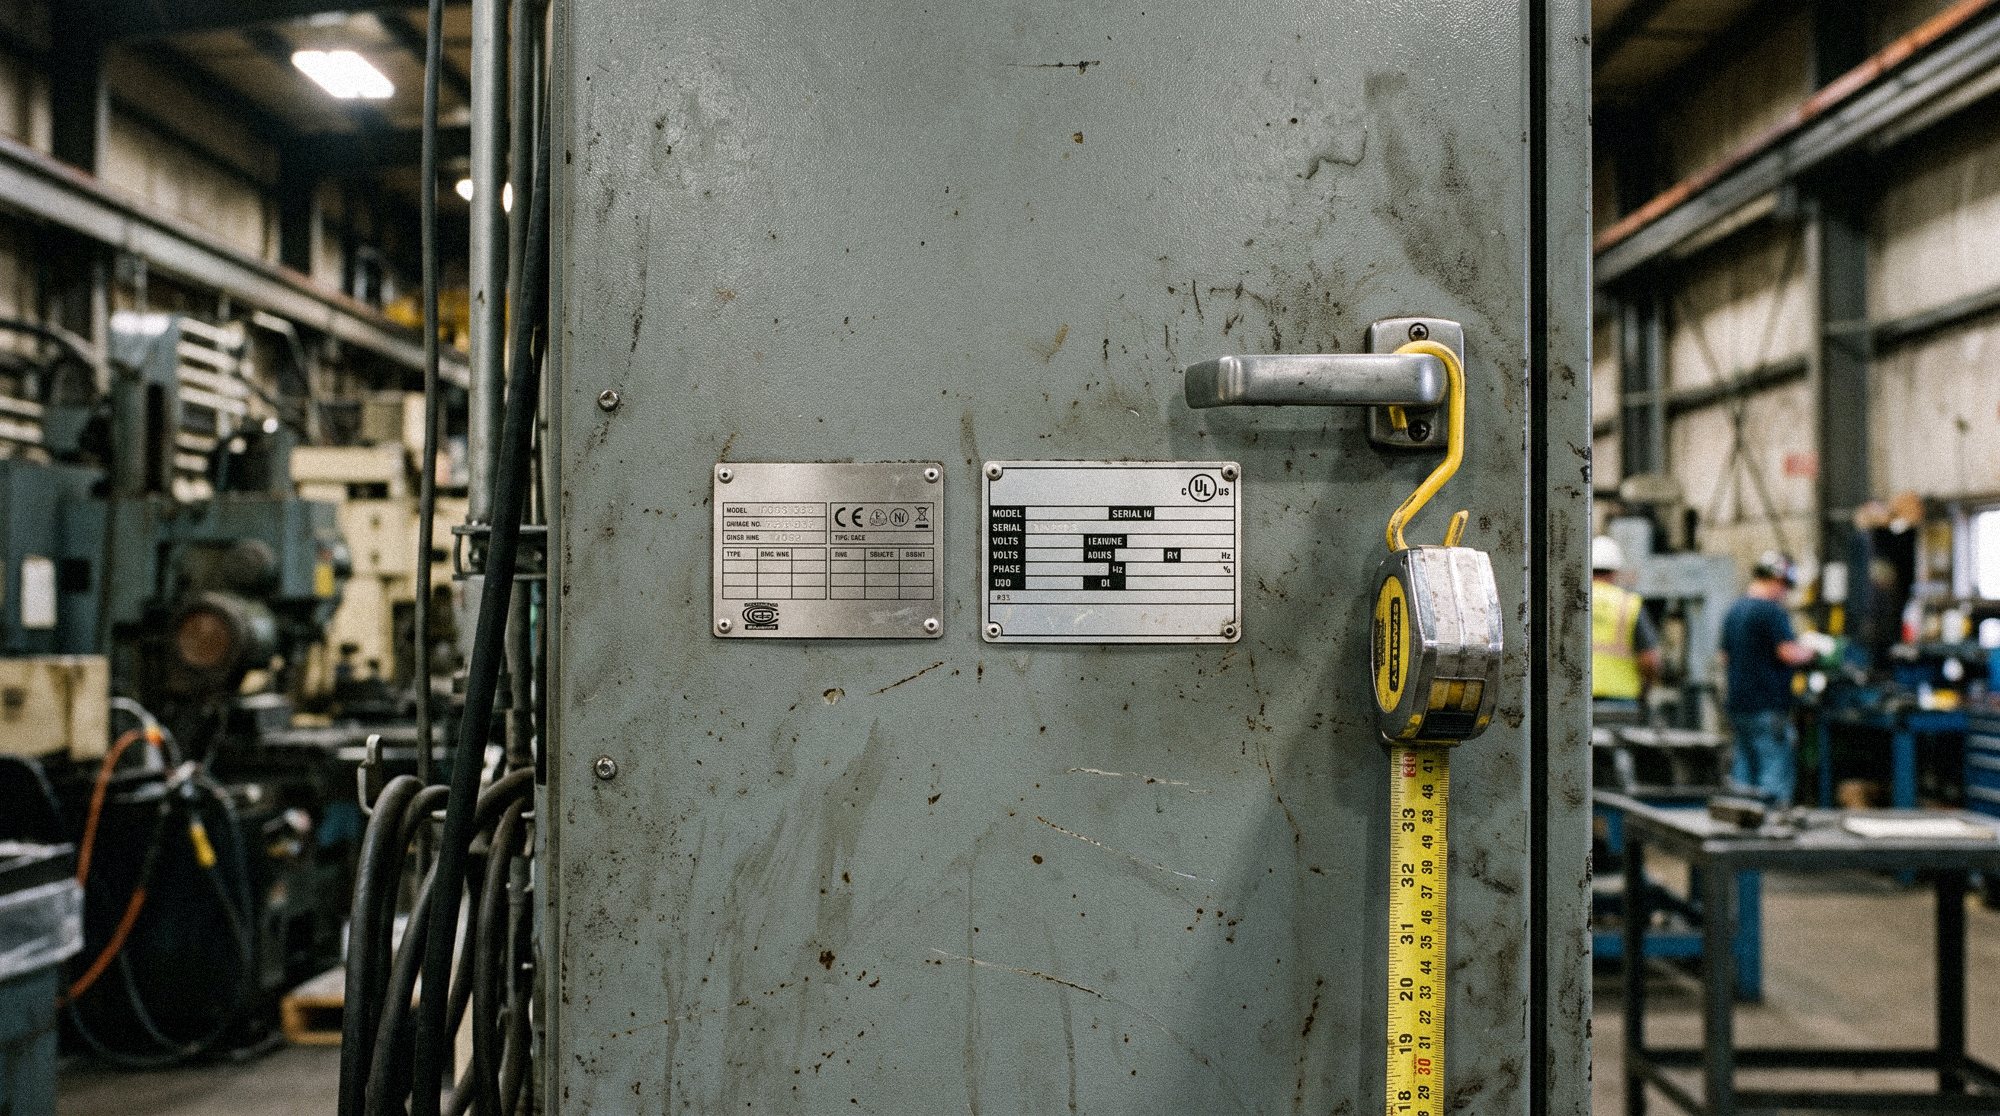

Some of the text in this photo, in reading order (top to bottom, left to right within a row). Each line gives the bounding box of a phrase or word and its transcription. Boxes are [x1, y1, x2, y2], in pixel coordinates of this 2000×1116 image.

[1194, 480, 1210, 496] UL
[1219, 488, 1230, 496] US
[834, 507, 864, 528] CE
[992, 509, 1022, 518] MODEL
[1112, 509, 1142, 518] SERIAL
[992, 523, 1022, 532] SERIAL
[992, 537, 1018, 545] VOLTS
[993, 551, 1018, 559] VOLTS
[993, 565, 1021, 573] PHASE
[1402, 808, 1416, 832] 33
[1422, 835, 1433, 849] 49
[1401, 864, 1414, 888] 32
[1421, 885, 1433, 899] 37
[1421, 910, 1432, 924] 46
[1401, 924, 1414, 945] 31
[1421, 936, 1432, 949] 35
[1420, 960, 1432, 975] 44
[1400, 978, 1414, 1001] 20
[1420, 985, 1432, 999] 33
[1419, 1010, 1431, 1024] 22
[1399, 1033, 1413, 1054] 19
[1419, 1036, 1431, 1049] 31
[1418, 1058, 1431, 1075] 30
[1418, 1085, 1430, 1100] 29
[1398, 1090, 1411, 1112] 18
